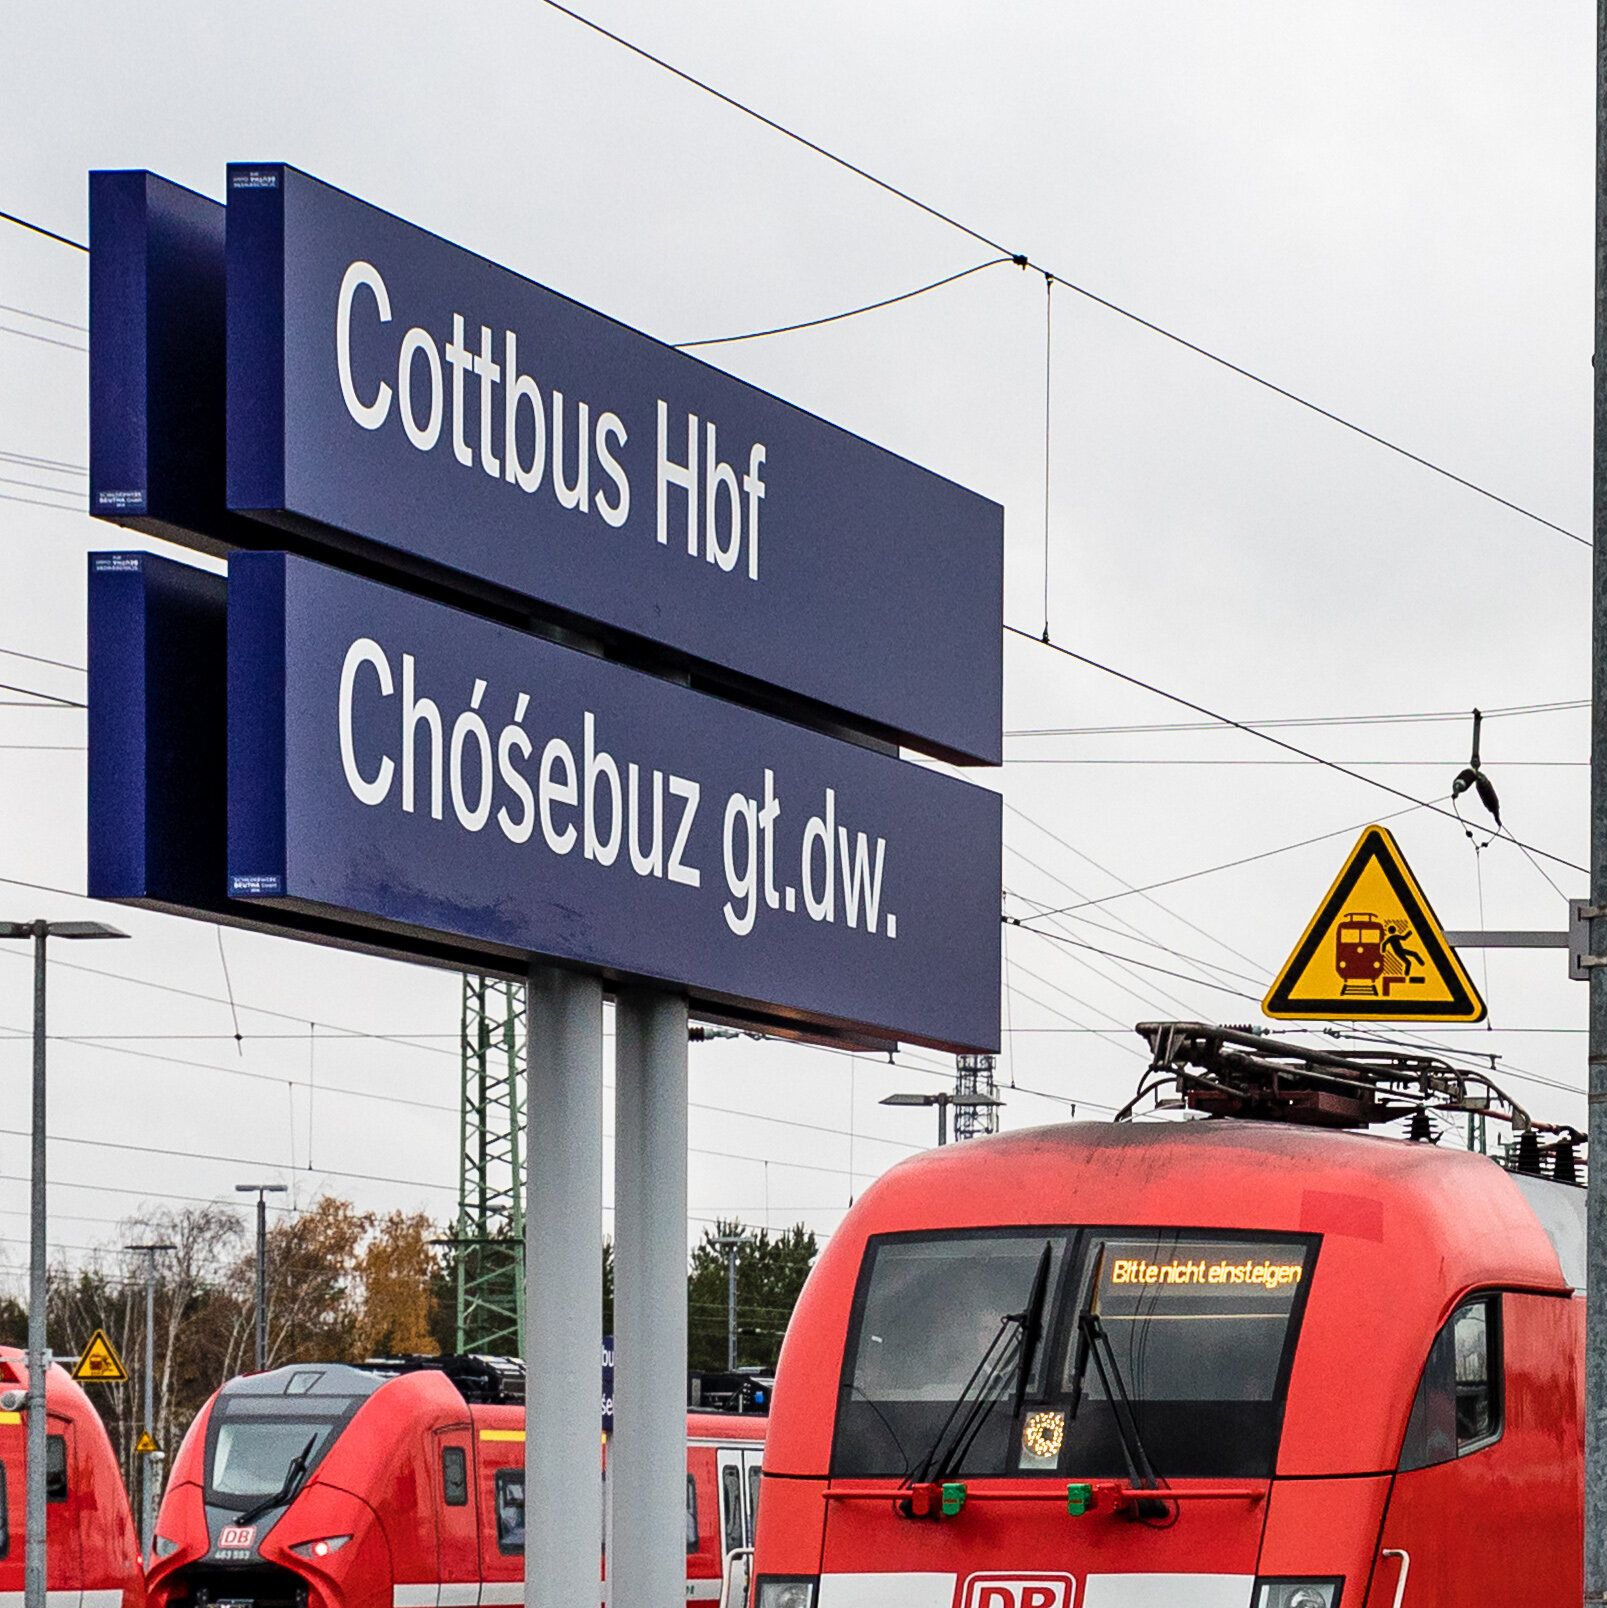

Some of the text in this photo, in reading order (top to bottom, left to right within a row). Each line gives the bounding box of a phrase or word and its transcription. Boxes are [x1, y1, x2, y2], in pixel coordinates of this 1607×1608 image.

[336, 260, 767, 580] Cottbus Hbf
[337, 637, 701, 887] Chóśebuz
[1112, 1259, 1303, 1289] Bitte nicht einsteigen
[225, 1529, 250, 1544] DB
